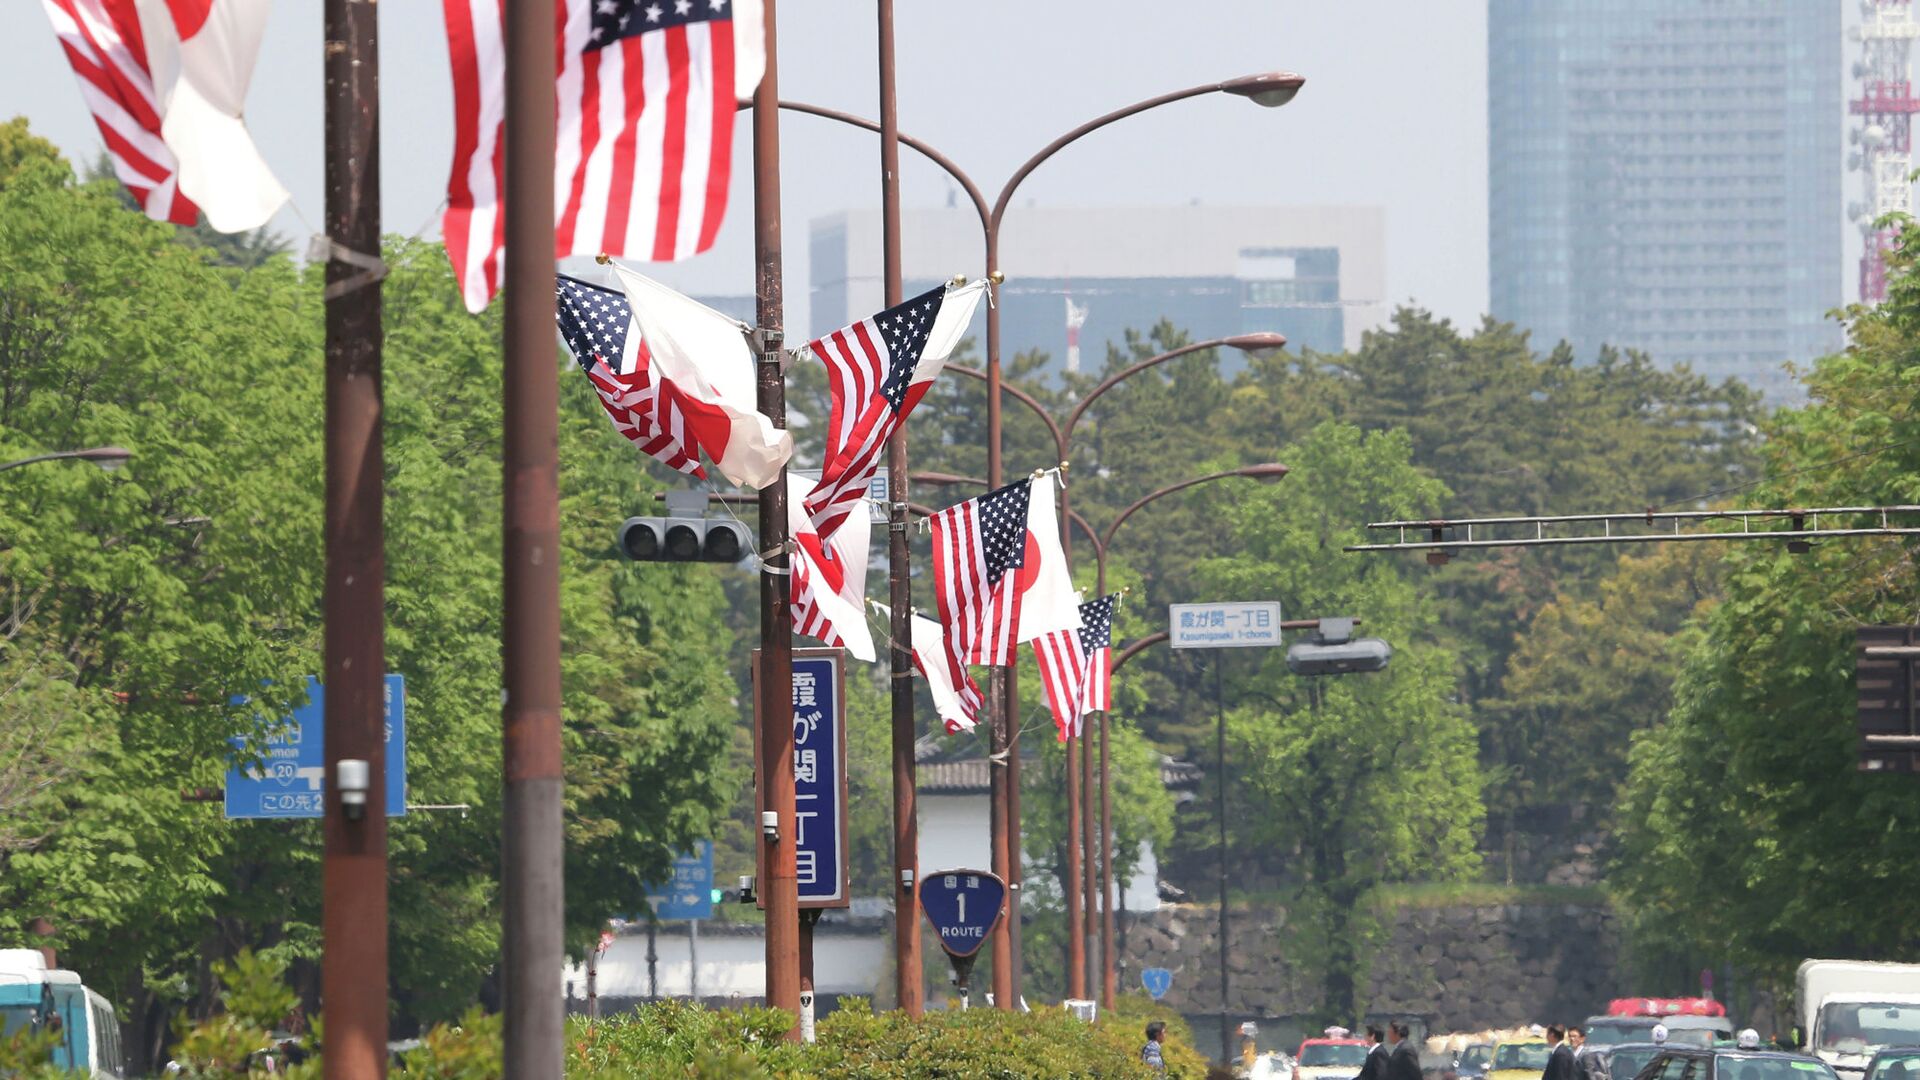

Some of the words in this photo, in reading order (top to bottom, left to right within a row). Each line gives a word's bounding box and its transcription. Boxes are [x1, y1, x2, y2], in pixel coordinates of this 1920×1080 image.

[277, 765, 293, 778] 20
[944, 875, 979, 889] 国道
[957, 893, 966, 923] 1
[942, 927, 983, 937] ROUTE
